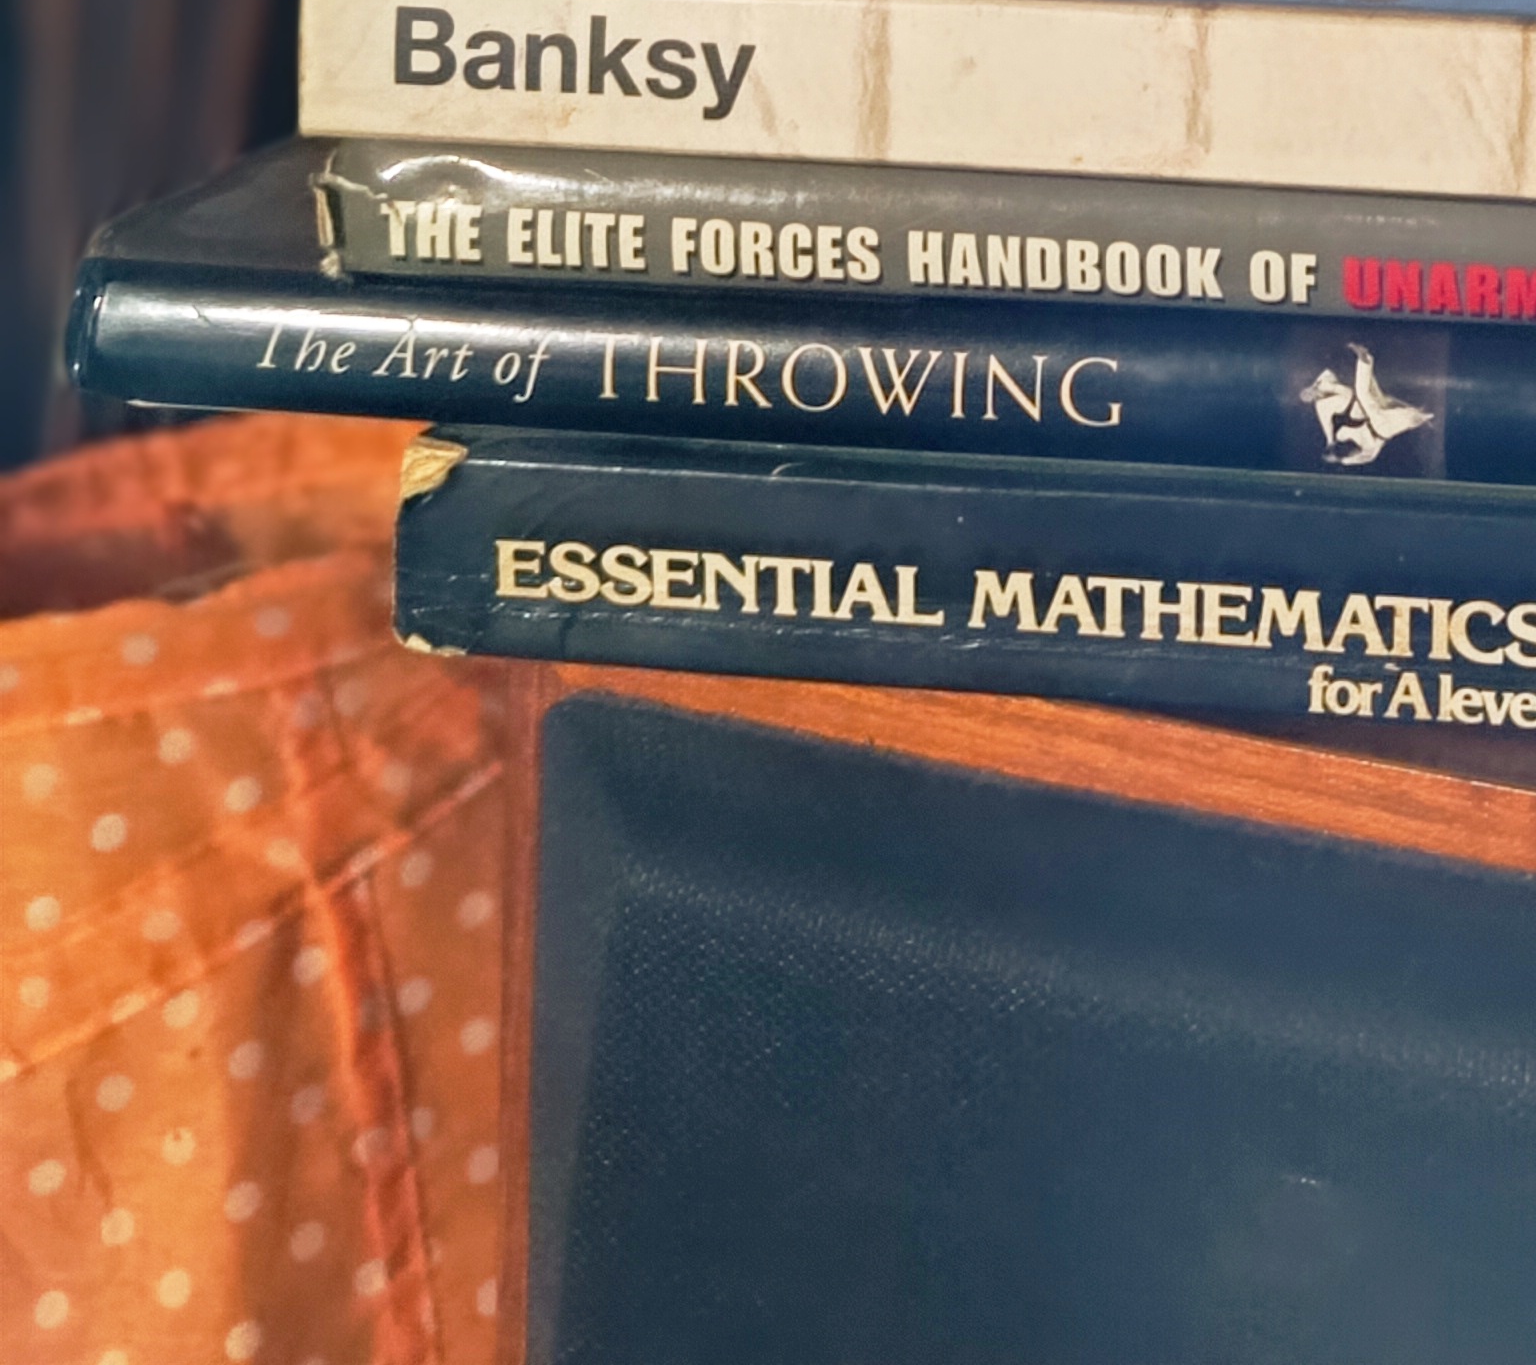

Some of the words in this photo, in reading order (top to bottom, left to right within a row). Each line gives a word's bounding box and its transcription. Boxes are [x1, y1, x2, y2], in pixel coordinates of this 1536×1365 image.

[392, 4, 757, 122] Banksy
[379, 199, 483, 265] THE
[506, 207, 647, 271] ELITE
[669, 217, 883, 283] FORCES
[906, 230, 1225, 302] HANDBOOK
[1249, 249, 1317, 305] OF
[256, 323, 356, 377] The
[372, 321, 470, 385] Art
[491, 326, 552, 404] of
[597, 331, 1124, 429] THROWING
[494, 538, 946, 627] ESSENTIAL
[1308, 665, 1383, 717] for
[1385, 677, 1431, 721] A
